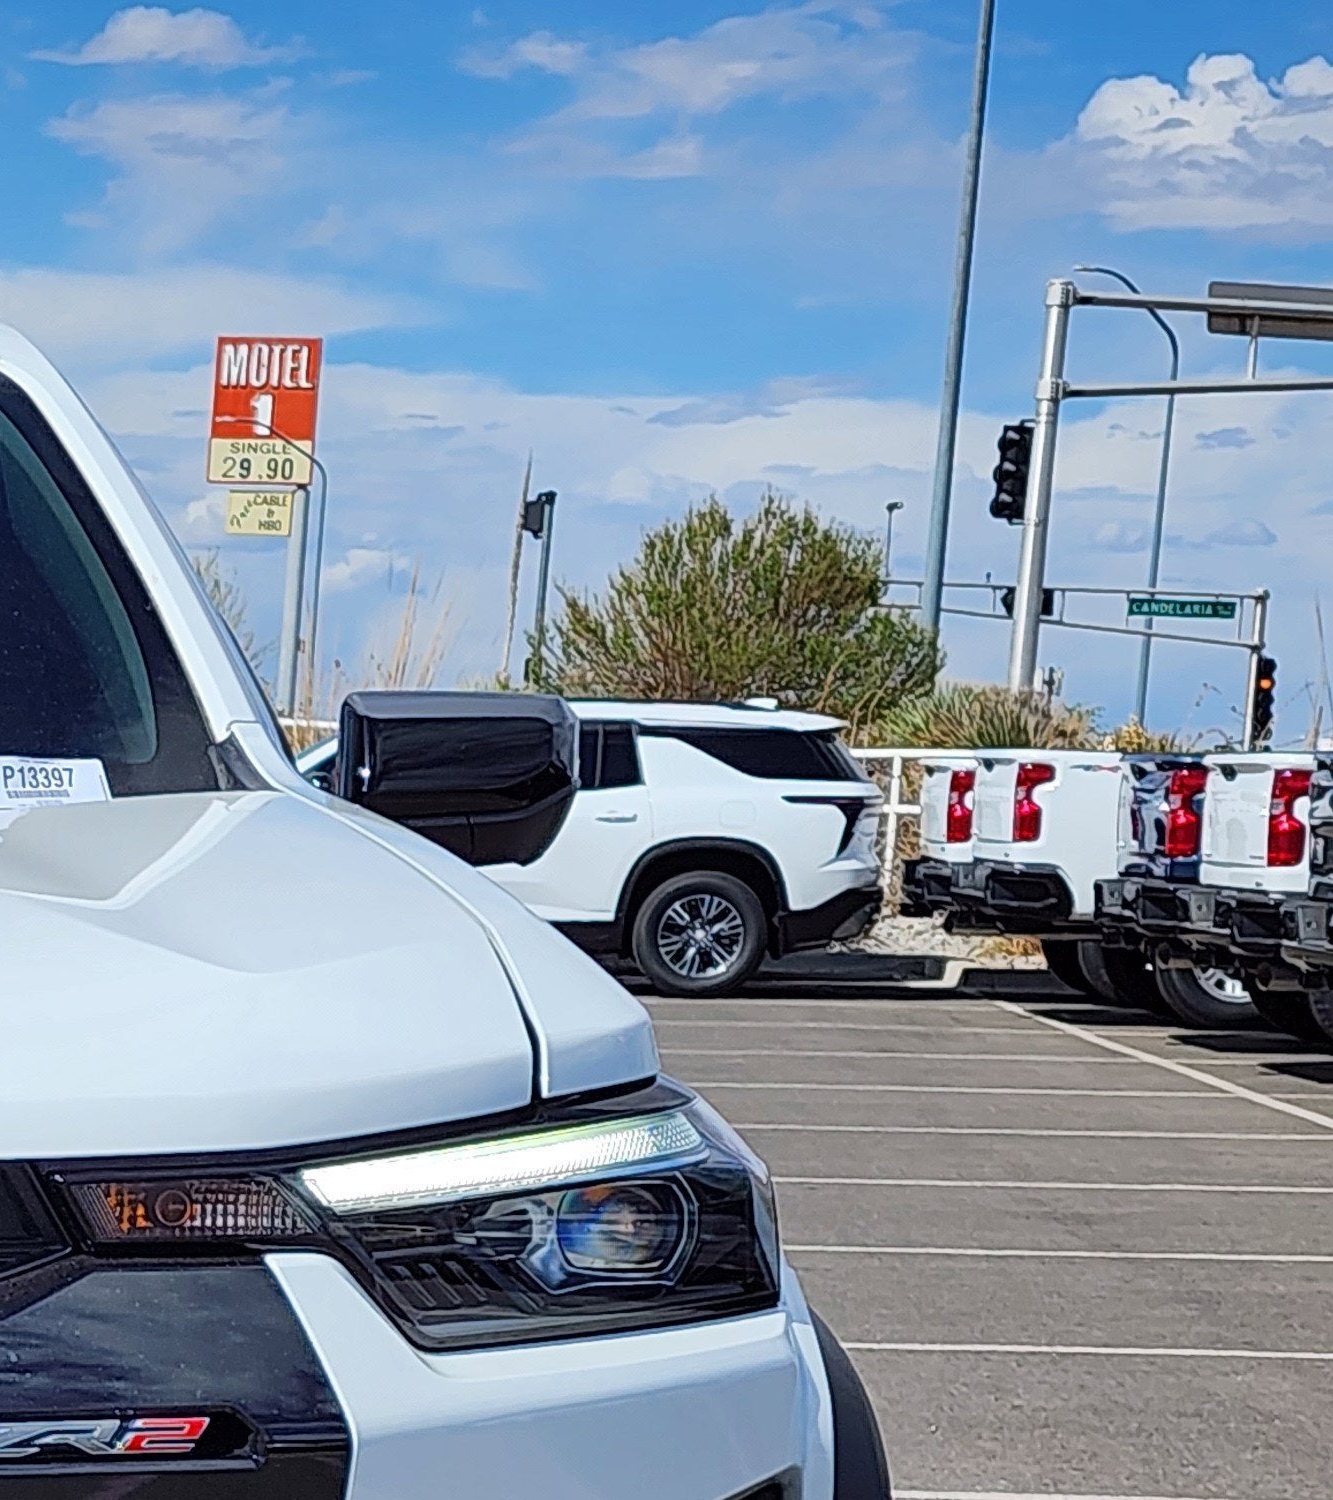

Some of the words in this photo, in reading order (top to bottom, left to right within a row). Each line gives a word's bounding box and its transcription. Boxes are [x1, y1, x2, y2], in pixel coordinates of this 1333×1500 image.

[219, 343, 314, 388] MOTEL
[250, 391, 273, 436] 1
[230, 442, 292, 455] SINGLE
[221, 456, 293, 481] 29.90
[1132, 601, 1213, 615] CANDELARIA
[2, 765, 74, 789] P13397
